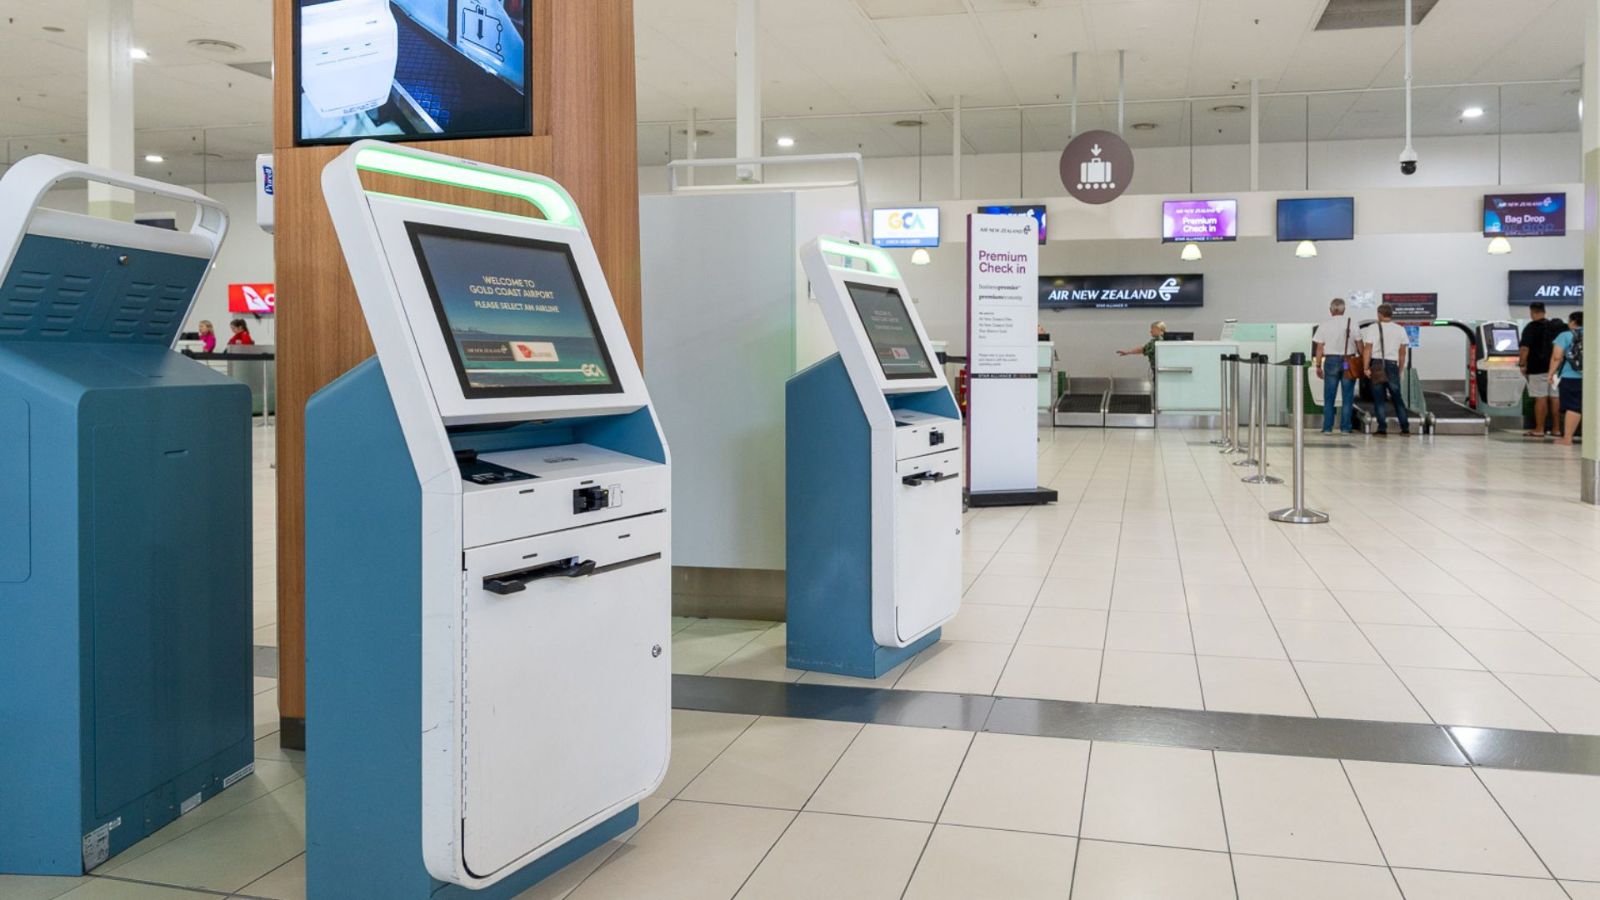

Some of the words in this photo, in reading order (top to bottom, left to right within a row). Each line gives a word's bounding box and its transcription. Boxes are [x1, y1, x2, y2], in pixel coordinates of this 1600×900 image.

[887, 212, 926, 230] GCA
[1182, 217, 1217, 225] Premium
[1504, 215, 1522, 224] Bag
[1523, 214, 1545, 223] Drop
[979, 250, 1027, 262] Premium
[979, 261, 1014, 273] Check
[1016, 263, 1026, 274] in
[482, 276, 523, 287] WELCOME
[523, 280, 535, 288] TO
[469, 284, 494, 295] GOLD
[494, 287, 522, 297] COAST
[523, 290, 555, 299] AIRPORT
[1048, 290, 1069, 300] AIR
[1071, 290, 1100, 300] NEW
[1100, 289, 1157, 300] ZEALAND
[1534, 285, 1561, 297] AIR
[1563, 285, 1584, 297] NE
[474, 300, 500, 310] PLEASE
[500, 302, 523, 311] SELECT
[535, 304, 560, 313] AIRLINE
[581, 363, 605, 377] GCA
